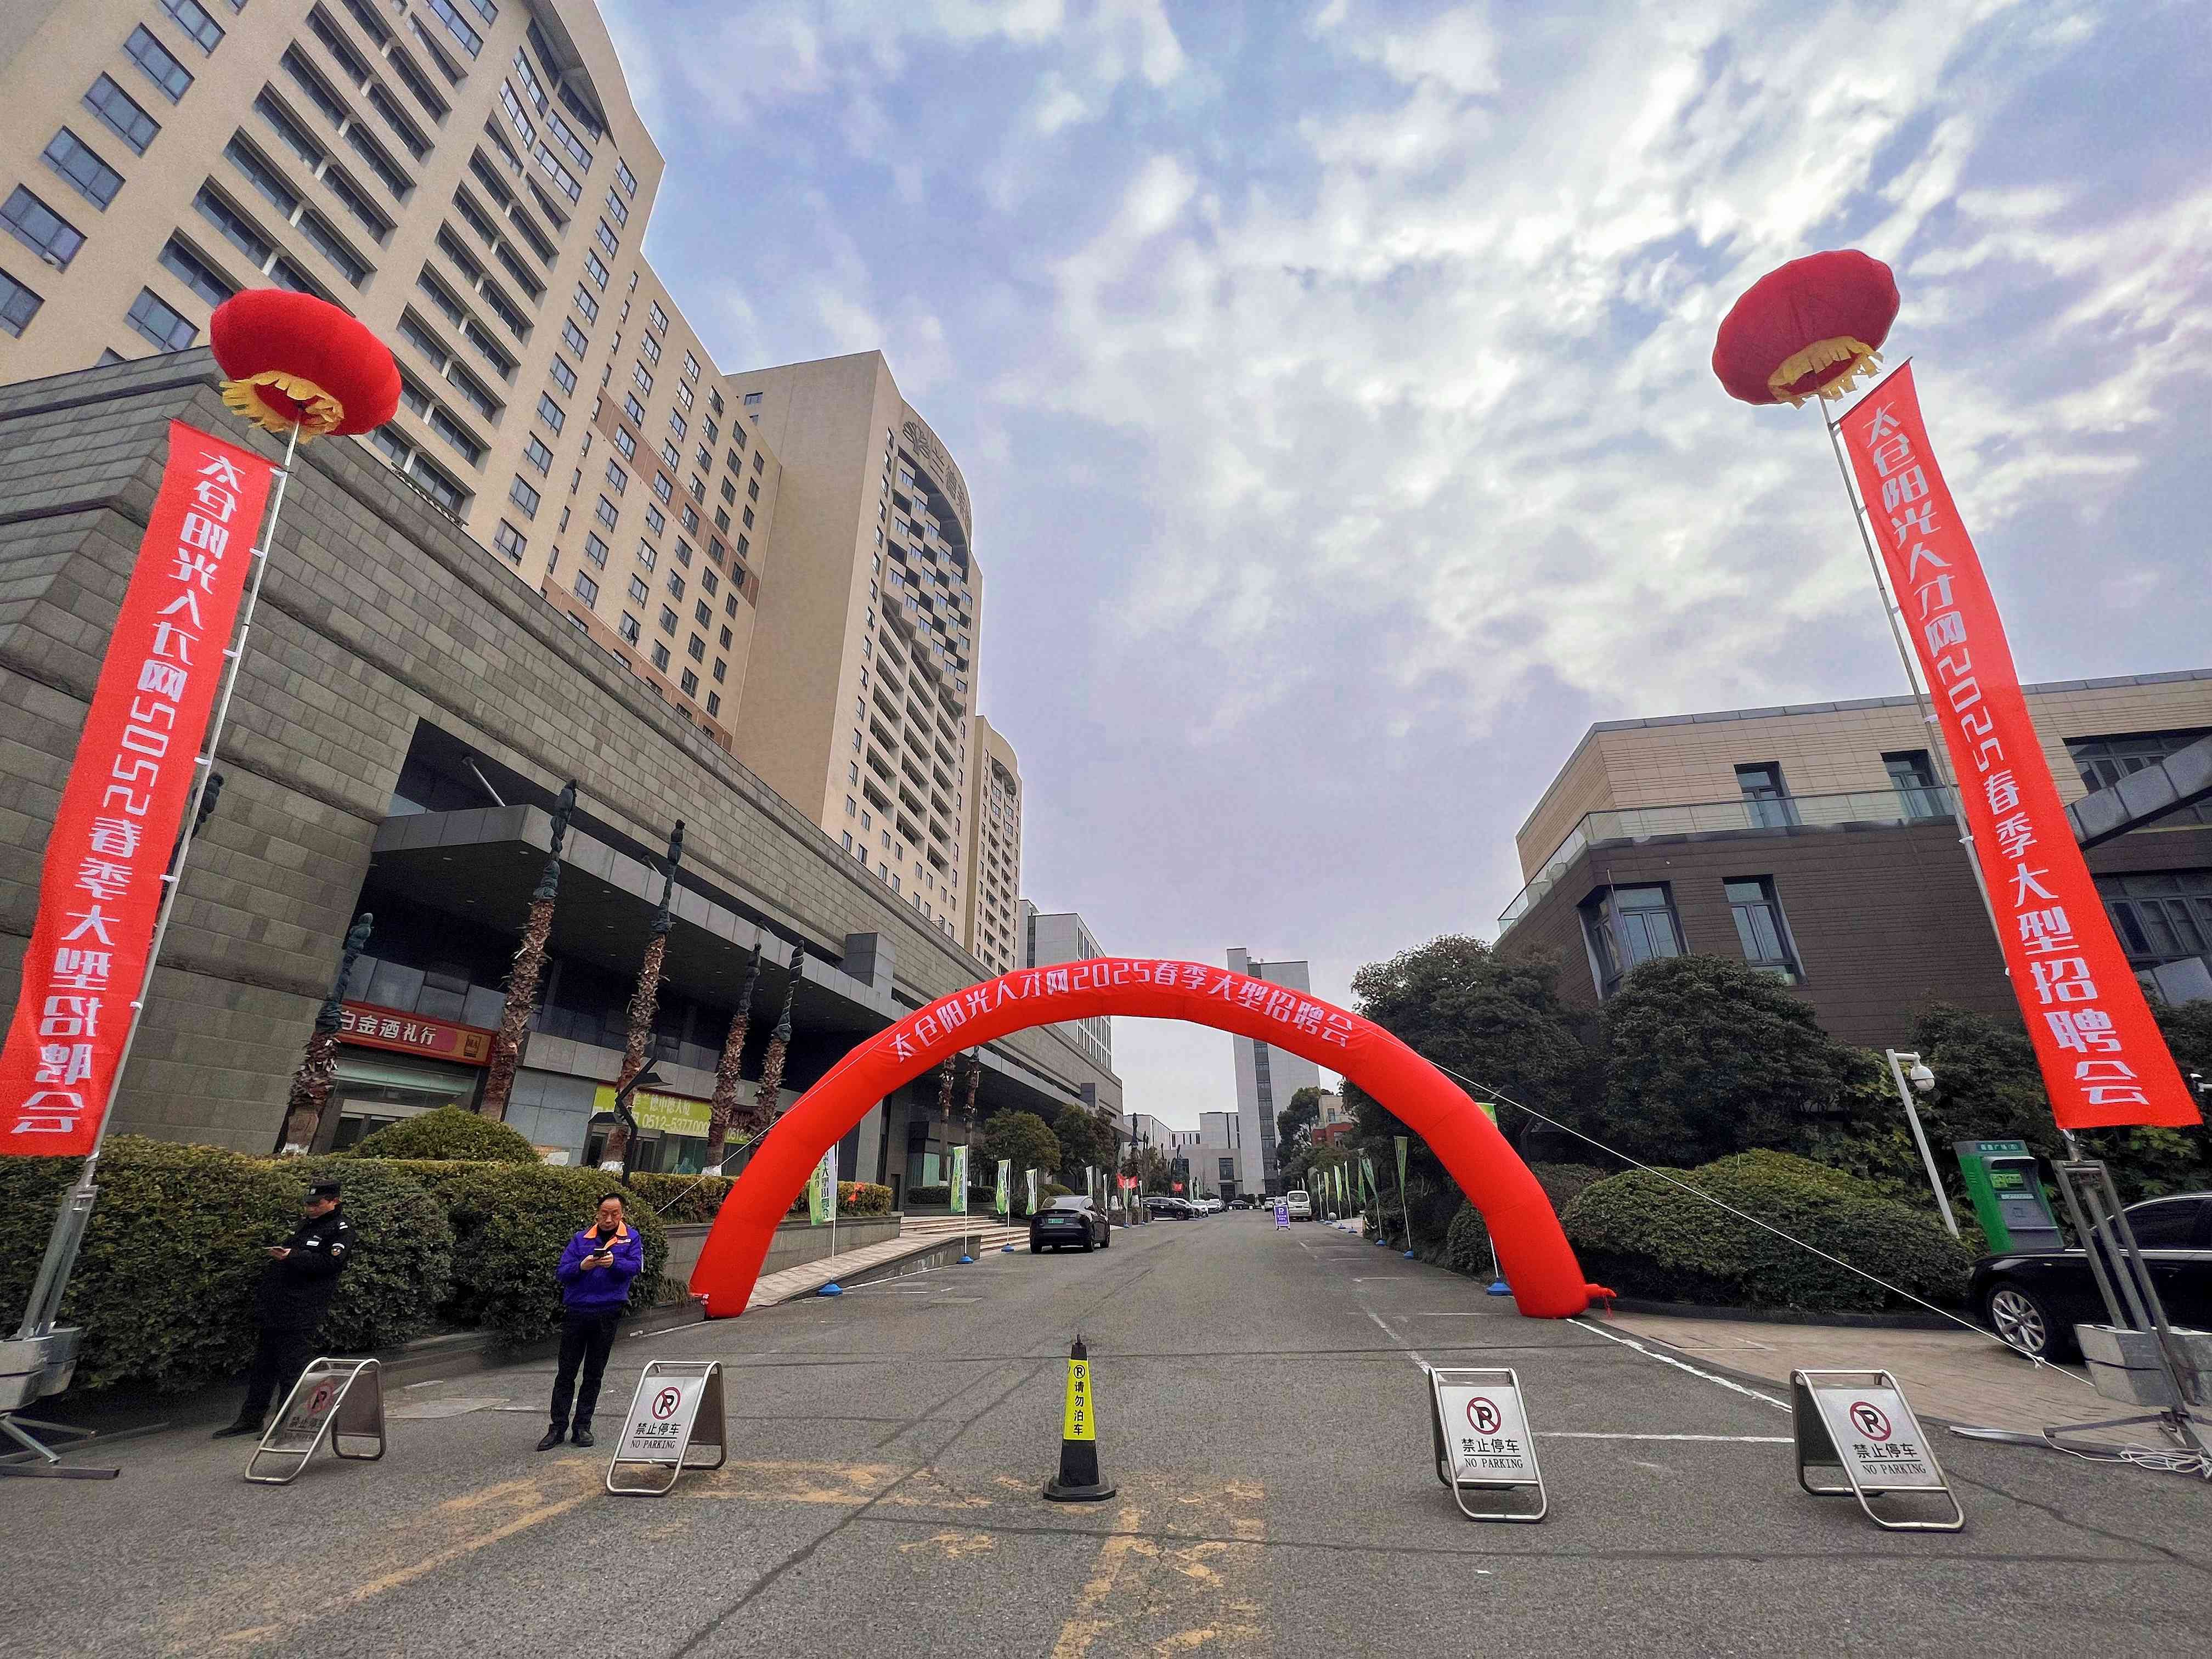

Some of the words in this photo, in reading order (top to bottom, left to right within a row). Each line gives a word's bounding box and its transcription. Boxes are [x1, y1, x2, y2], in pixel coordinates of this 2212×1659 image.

[1863, 401, 2150, 1105] 太仓阳光人才网2025春季大型招聘会
[889, 961, 1353, 1062] 太仓阳光人才网2025春季大型招聘会
[1074, 1381, 1084, 1436] 请勿泊车
[636, 1423, 681, 1436] 禁止停车
[630, 1440, 640, 1448] NO
[643, 1440, 676, 1448] PARKING
[1462, 1438, 1520, 1453] 禁止停车
[1852, 1443, 1917, 1459] 禁止停车
[1464, 1458, 1477, 1468] NO
[1482, 1458, 1523, 1469] PARKING
[1863, 1464, 1877, 1475] NO
[1881, 1464, 1927, 1475] PARKING
